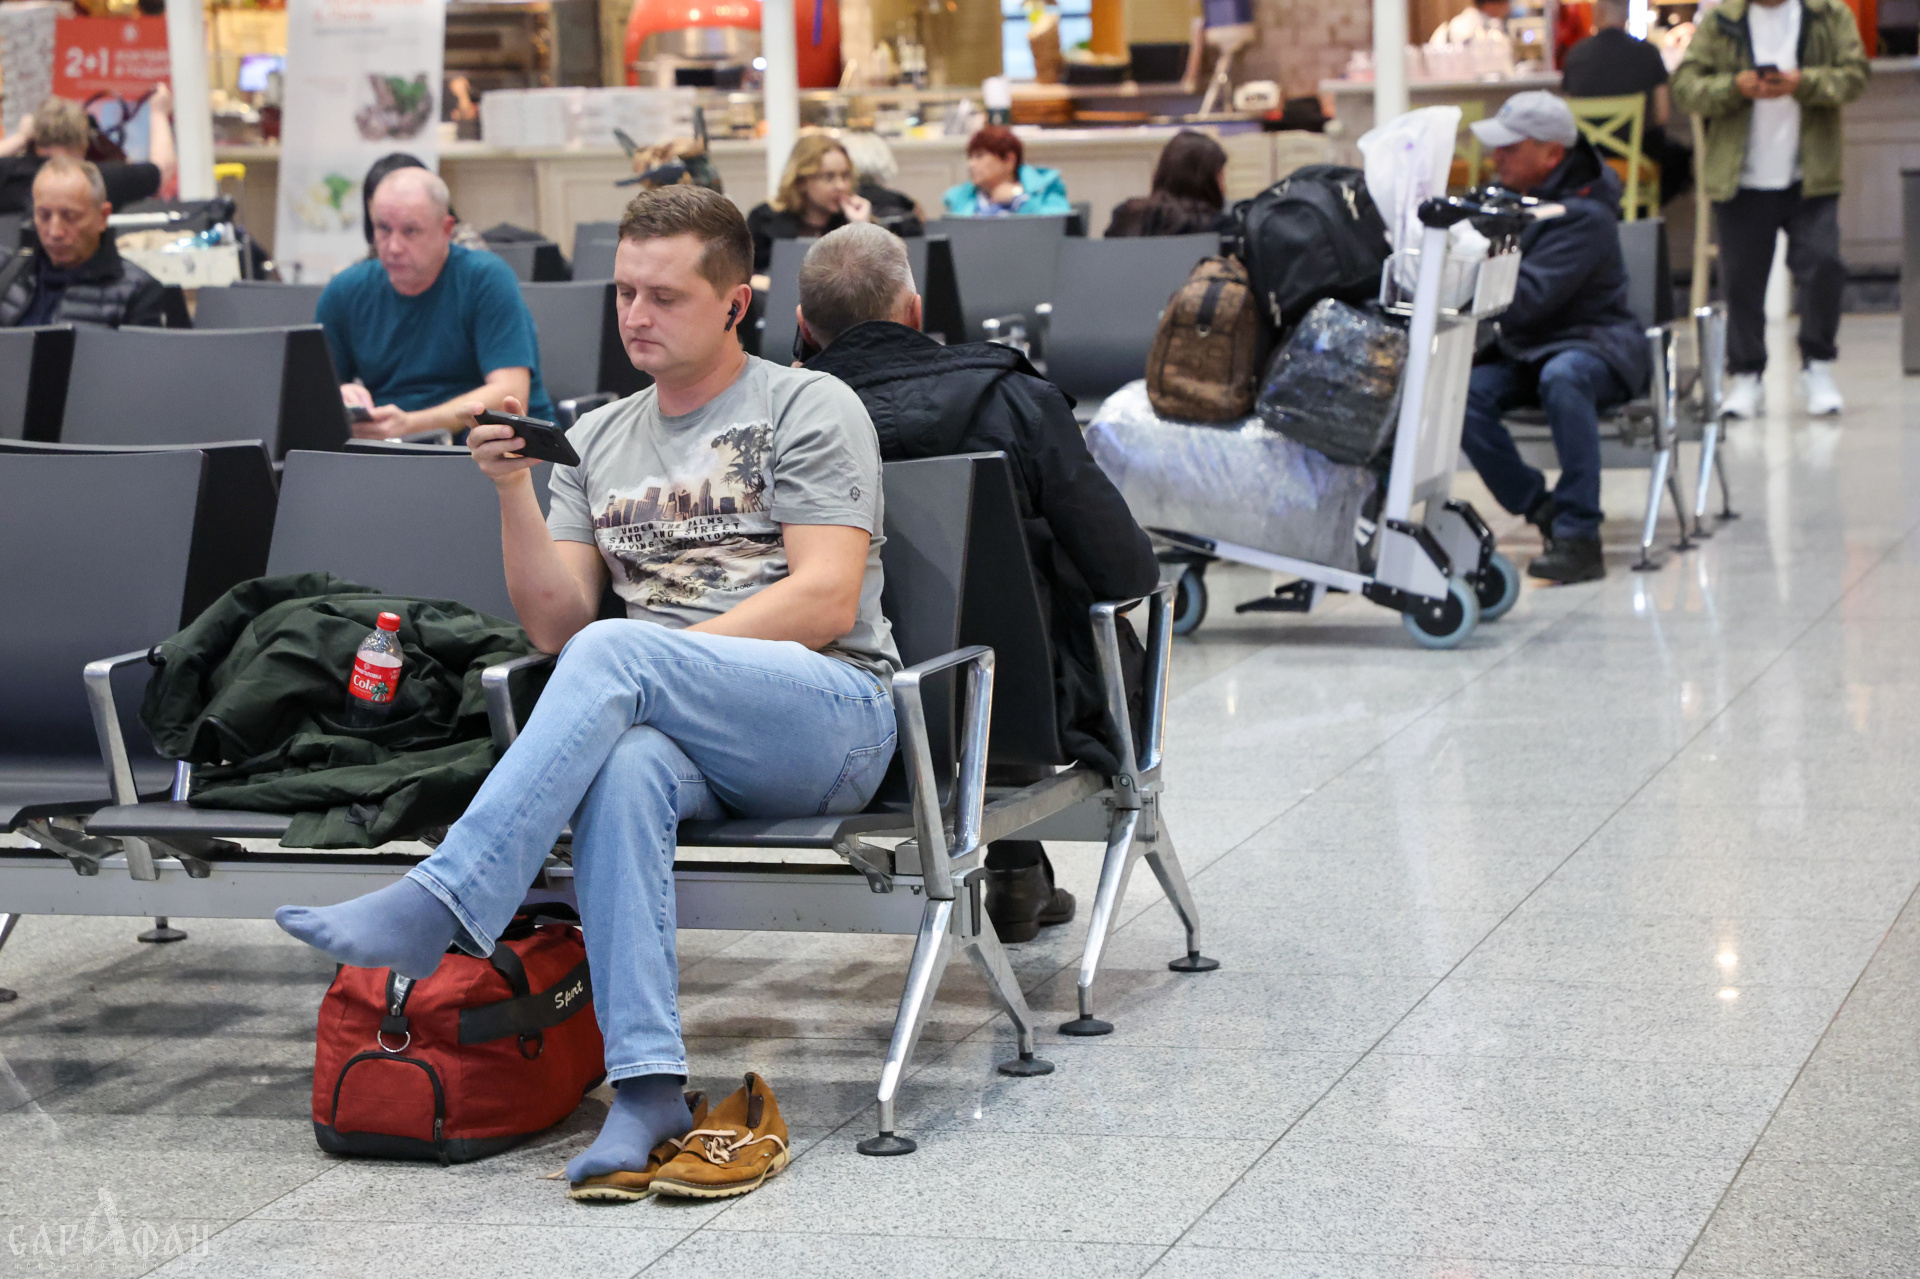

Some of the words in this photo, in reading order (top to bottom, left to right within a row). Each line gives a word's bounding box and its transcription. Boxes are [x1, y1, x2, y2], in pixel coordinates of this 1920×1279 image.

[65, 46, 109, 78] 2+1
[609, 533, 643, 545] SAND
[653, 529, 675, 539] AND
[685, 522, 740, 536] STREET
[621, 522, 654, 535] UNDER
[661, 522, 681, 530] THE
[688, 516, 724, 529] PALMS
[676, 531, 740, 542] WNTO
[353, 674, 376, 691] Cola
[554, 980, 584, 1009] Sport
